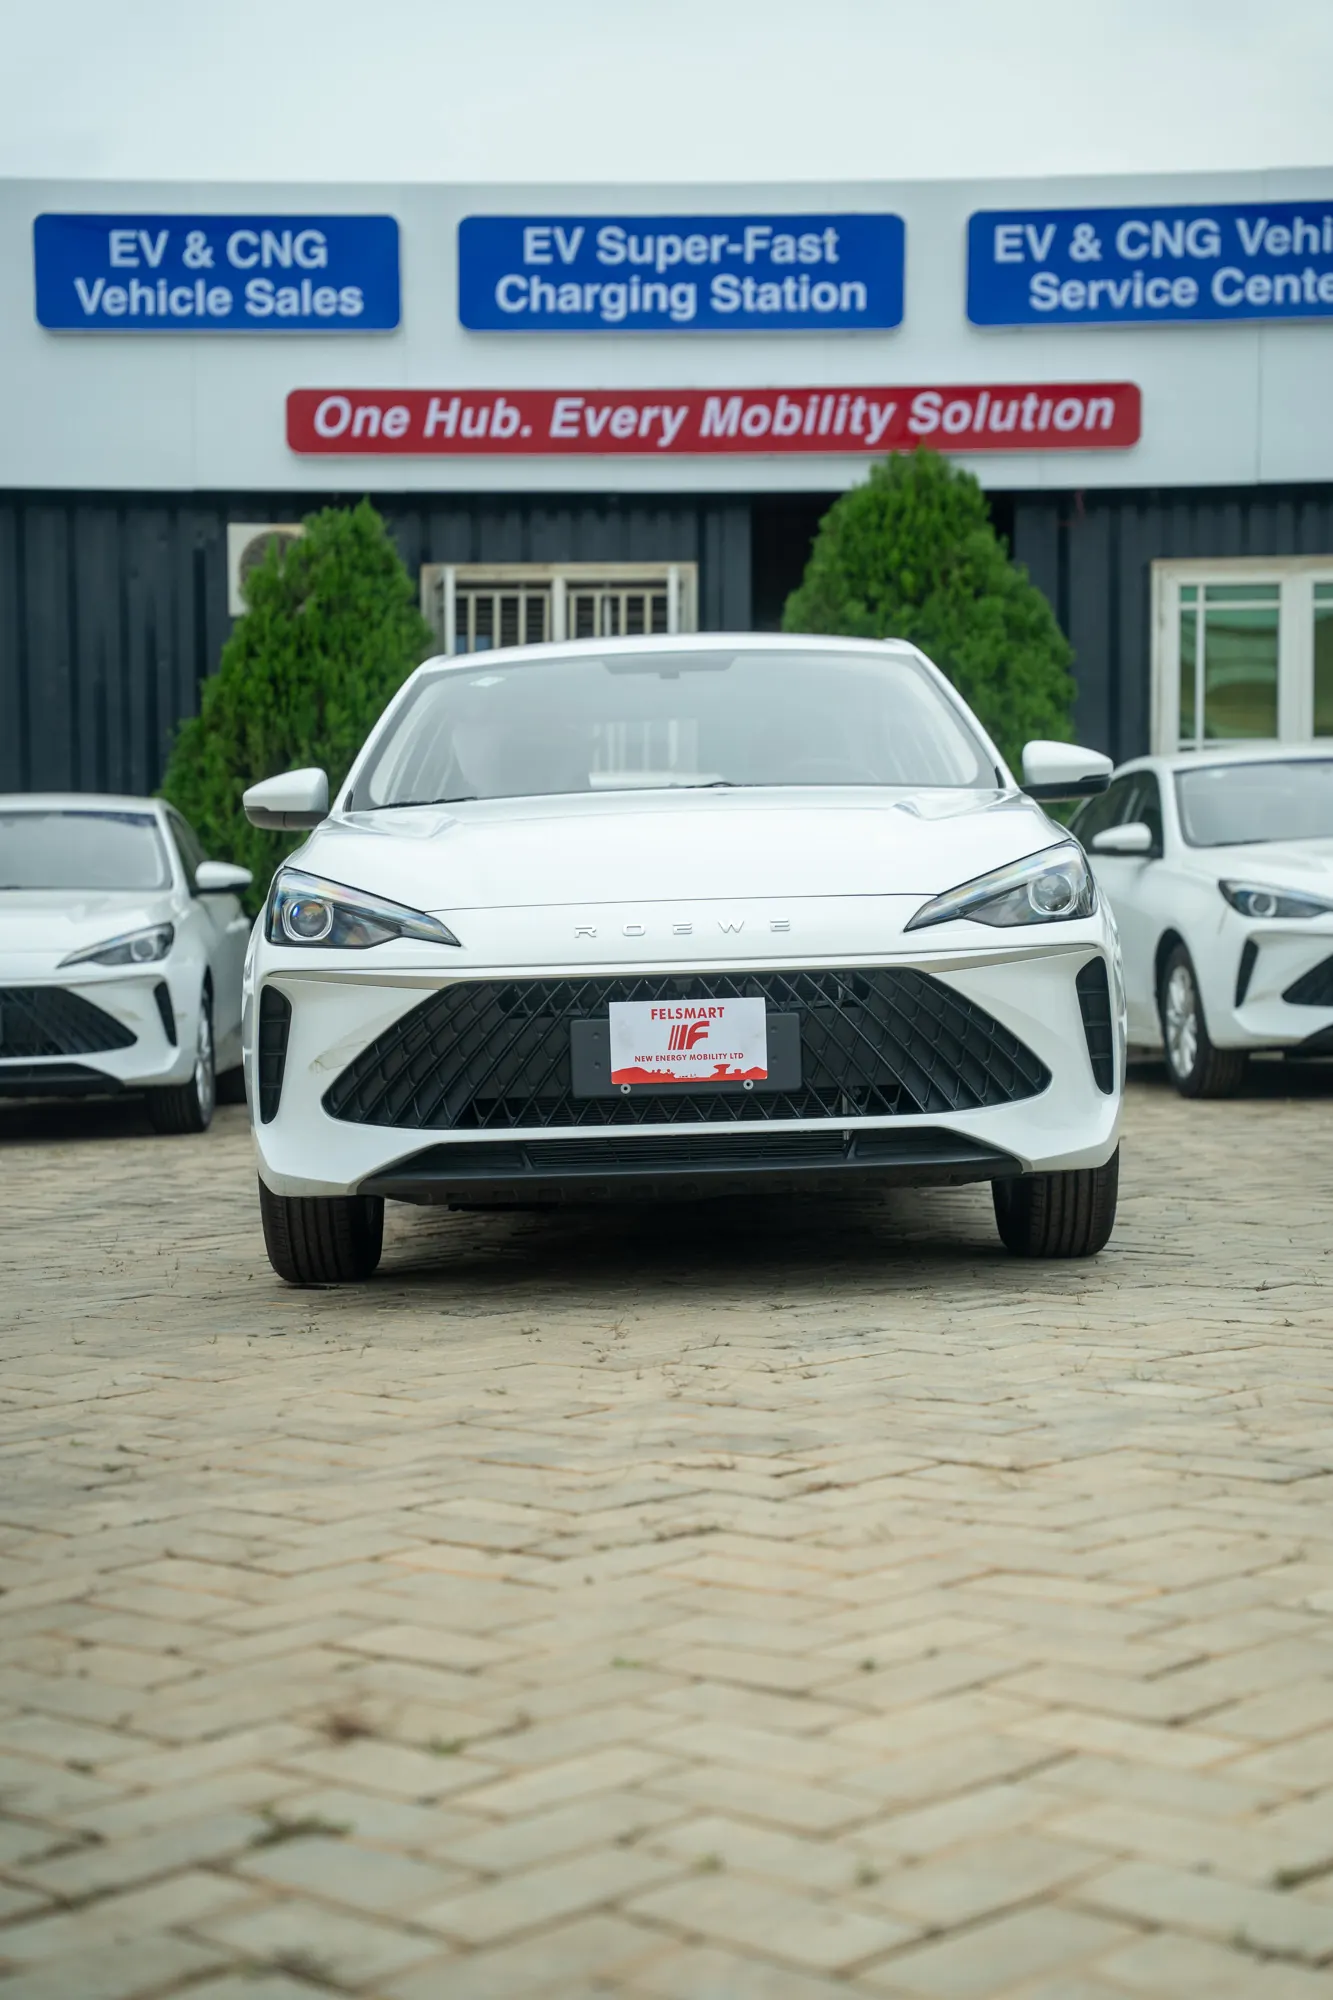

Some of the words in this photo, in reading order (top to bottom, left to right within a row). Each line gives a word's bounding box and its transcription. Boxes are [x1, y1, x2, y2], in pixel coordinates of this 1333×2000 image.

[109, 230, 169, 268] EV
[182, 230, 214, 269] &
[226, 230, 328, 269] CNG
[523, 226, 585, 265] EV
[596, 225, 839, 274] Super-Fast
[994, 223, 1056, 263] EV
[1068, 222, 1102, 262] &
[1115, 218, 1221, 260] CNG
[1235, 214, 1333, 256] Vehi
[74, 277, 233, 317] Vehicle
[244, 277, 364, 317] Sales
[494, 273, 697, 322] Charging
[710, 273, 868, 313] Station
[1029, 269, 1199, 311] Service
[312, 394, 411, 439] One
[422, 396, 533, 440] Hub.
[548, 396, 690, 447] Every
[698, 393, 898, 446] Mobility
[906, 390, 1117, 434] Solution
[573, 918, 792, 939] ROEWE
[650, 1006, 726, 1021] FELSMART
[634, 1054, 653, 1063] NEW
[655, 1053, 687, 1062] ENERGY
[689, 1052, 728, 1061] MOBILITY
[729, 1052, 745, 1060] LTD
